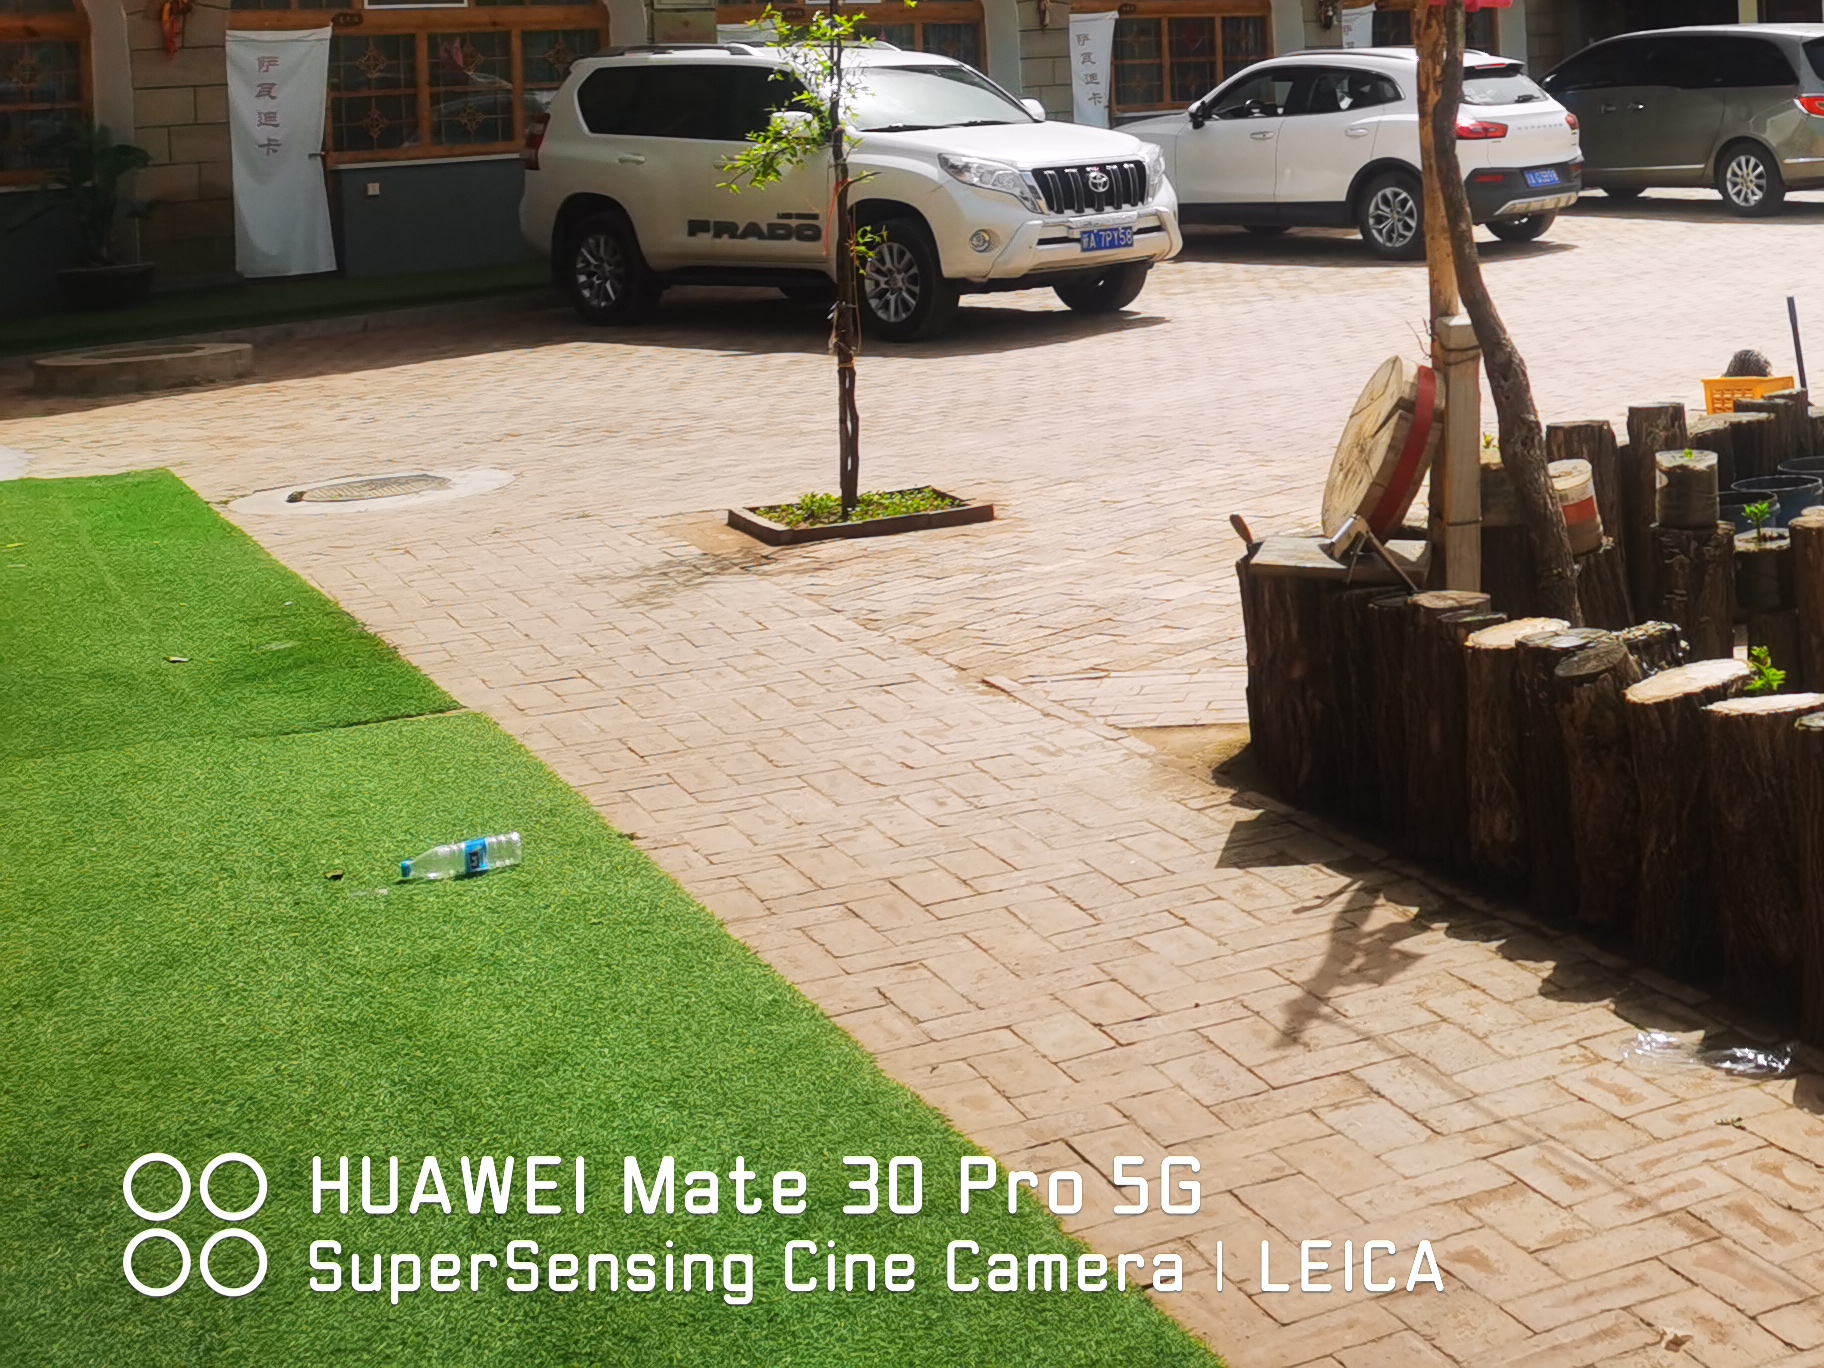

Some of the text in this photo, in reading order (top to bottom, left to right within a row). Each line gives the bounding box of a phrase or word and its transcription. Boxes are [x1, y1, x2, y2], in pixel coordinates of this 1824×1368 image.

[255, 55, 283, 156] 萨瓦迪卡
[1074, 33, 1103, 107] 萨瓦迪卡
[687, 219, 822, 243] PRADO
